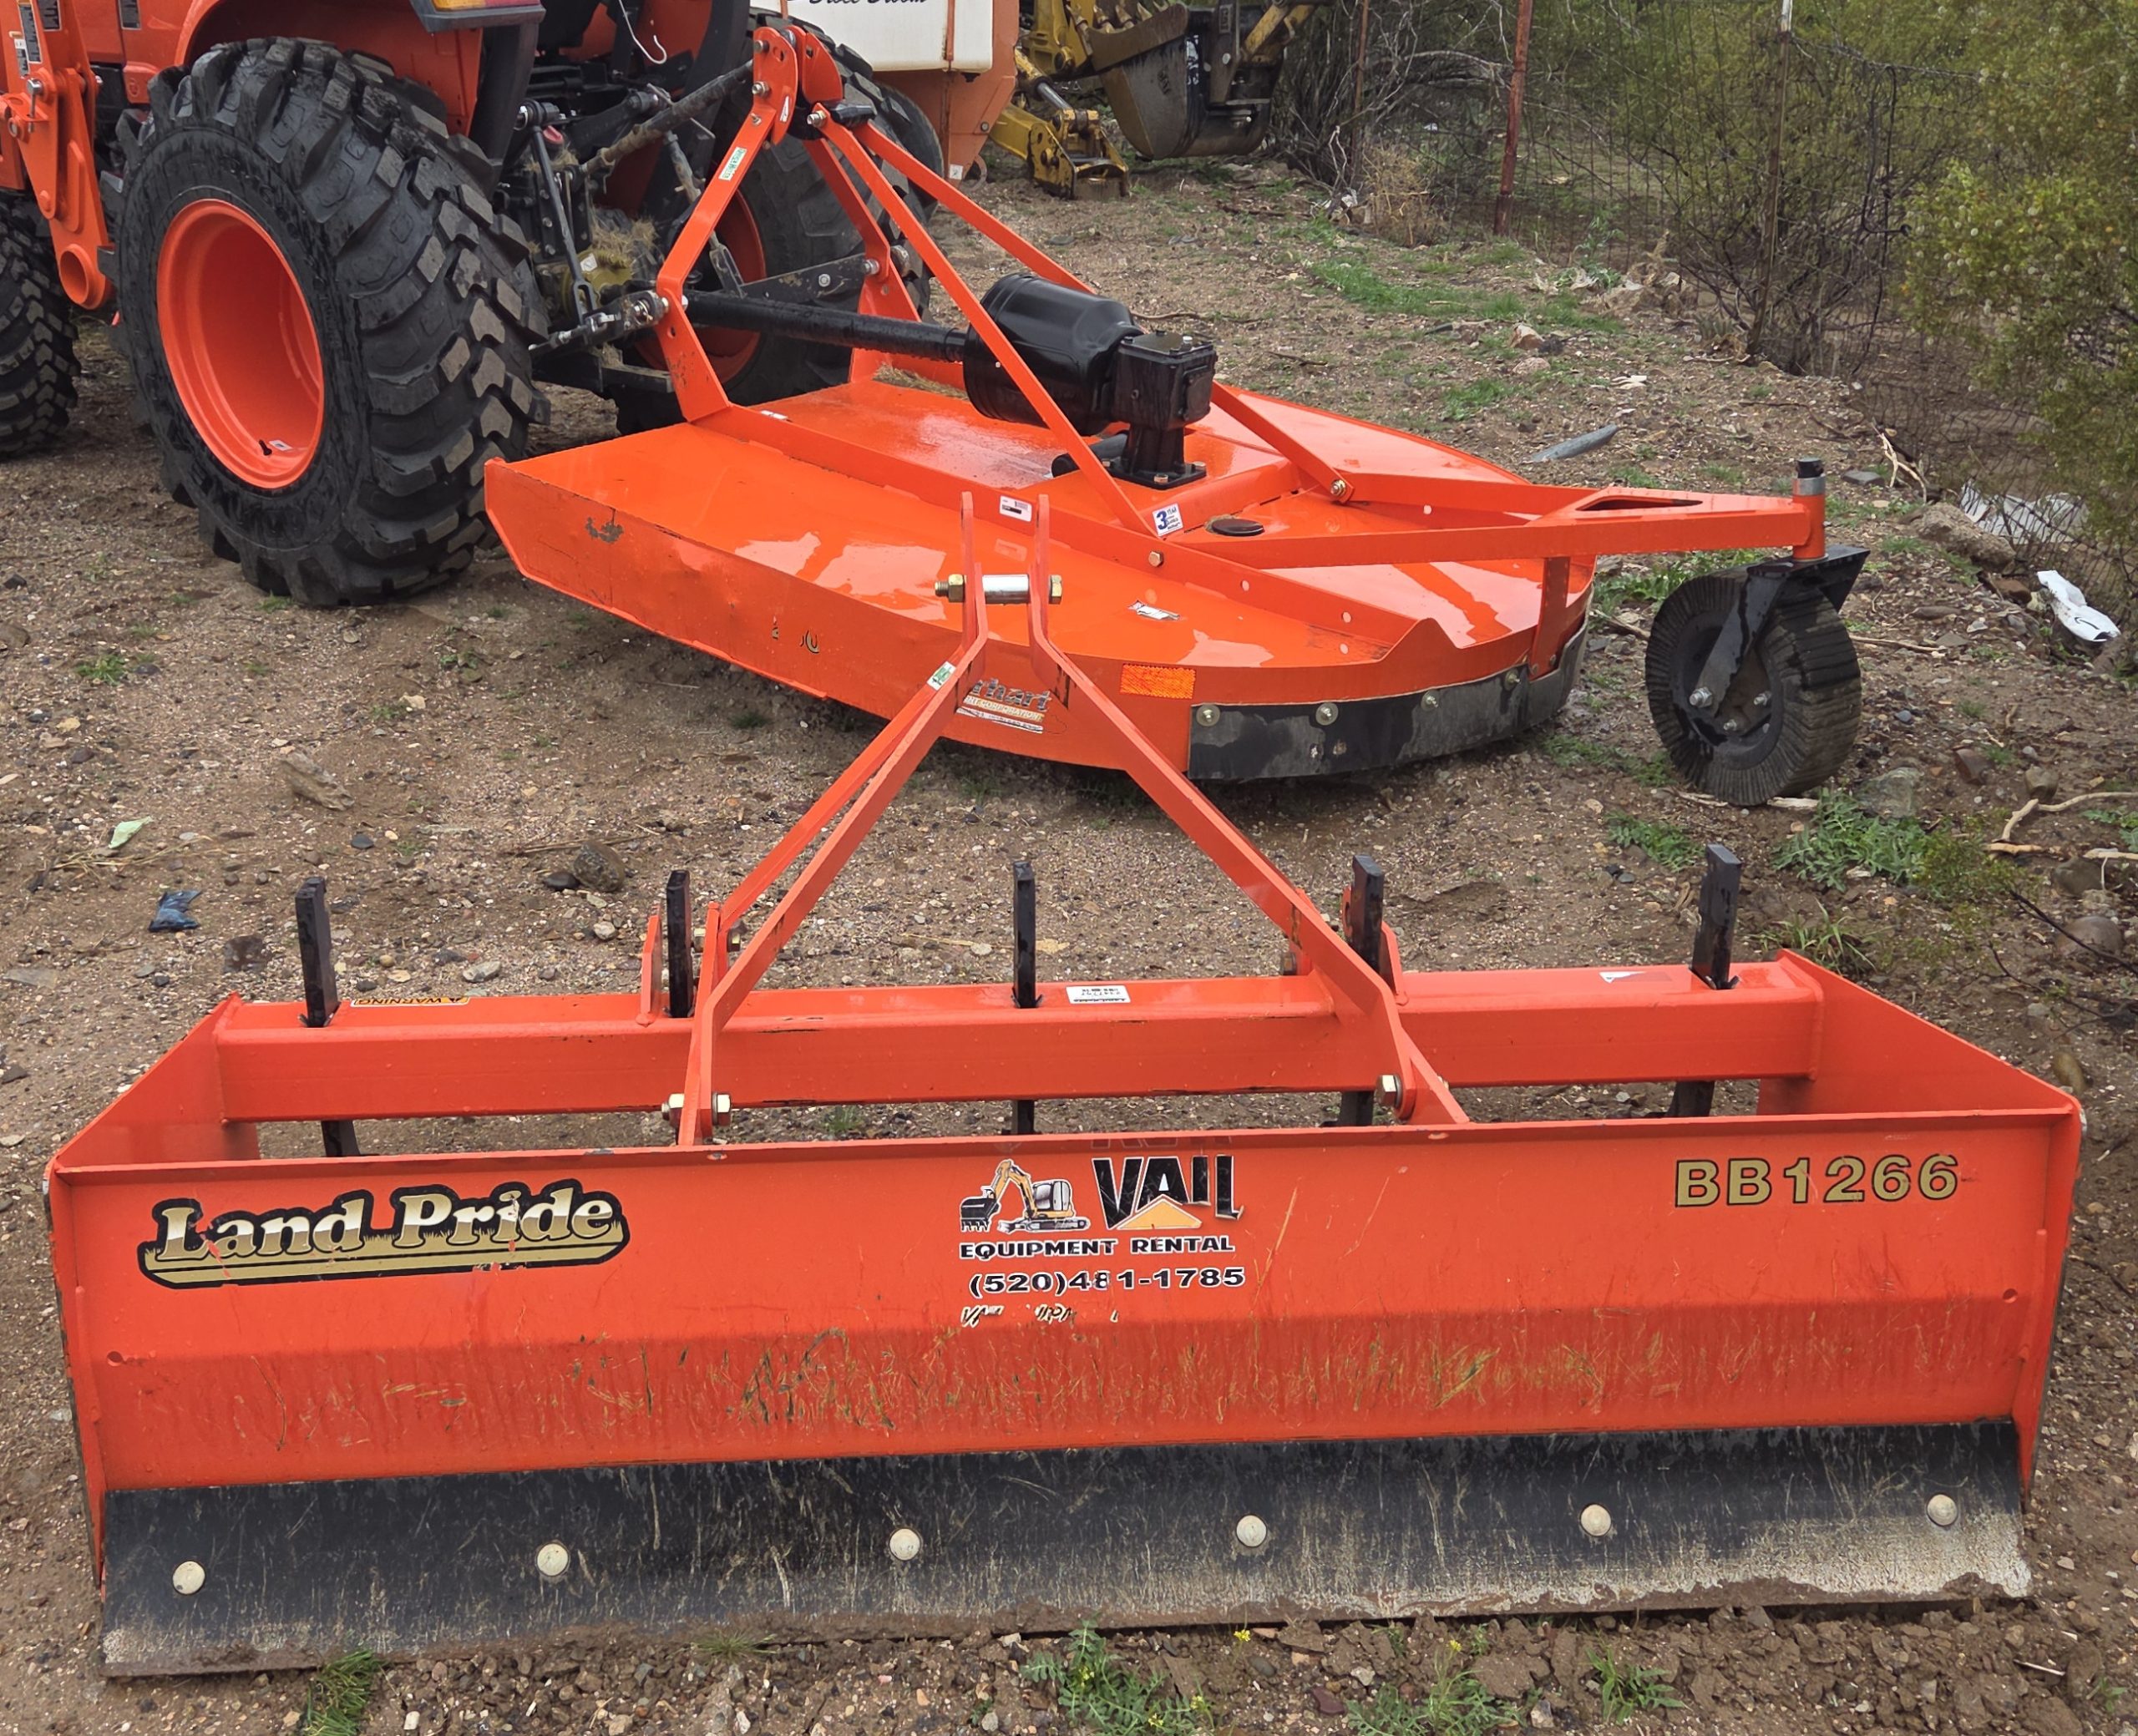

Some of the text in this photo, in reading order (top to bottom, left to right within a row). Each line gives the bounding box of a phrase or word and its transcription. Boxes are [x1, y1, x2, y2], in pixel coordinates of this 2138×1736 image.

[1156, 510, 1168, 530] 3
[1090, 1154, 1245, 1230] VAIL
[1674, 1153, 1958, 1208] BB1266
[157, 1188, 614, 1262] Land Pride
[959, 1235, 1236, 1261] EQUIPMENT RENTAL
[968, 1267, 1246, 1299] (520)481-1785
